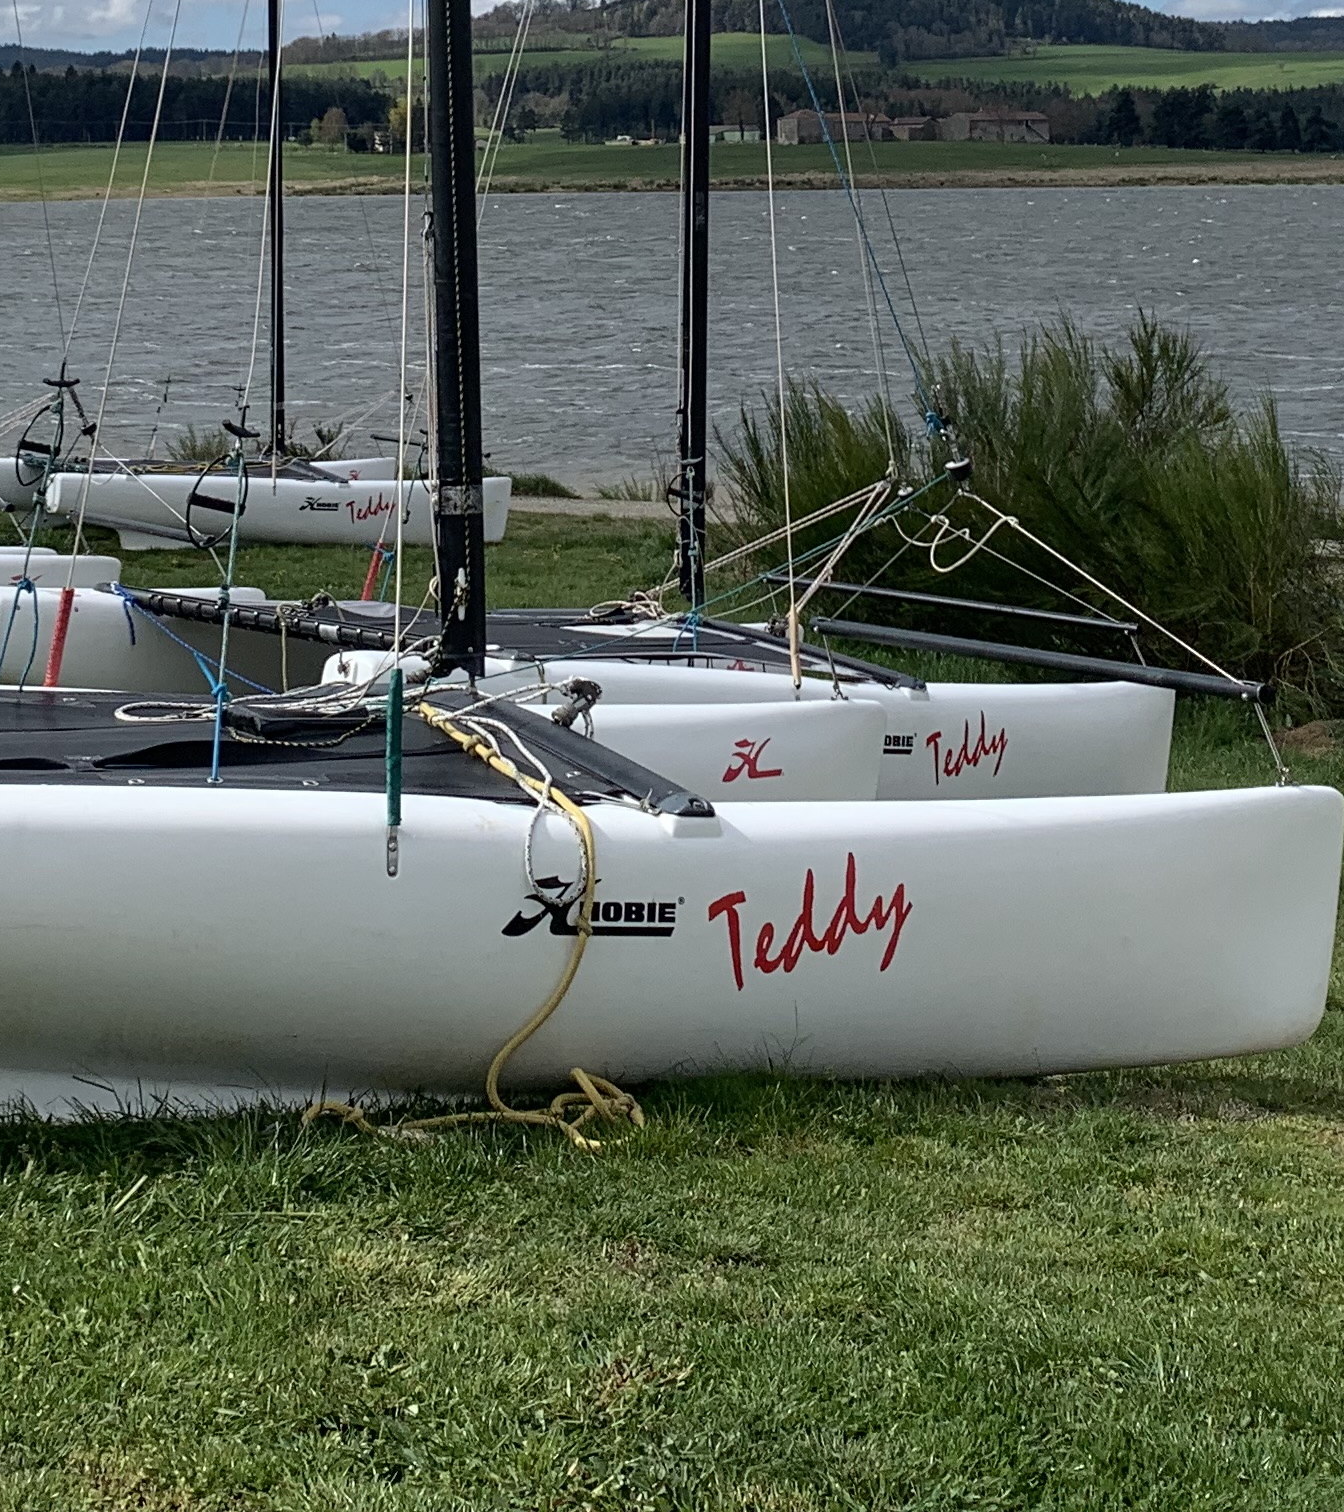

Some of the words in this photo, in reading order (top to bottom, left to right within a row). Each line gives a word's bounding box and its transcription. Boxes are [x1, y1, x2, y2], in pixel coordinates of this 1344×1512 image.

[345, 491, 396, 524] Teddy
[884, 734, 914, 748] OBIE
[925, 710, 1008, 786] Teddy
[708, 852, 913, 991] Teddy
